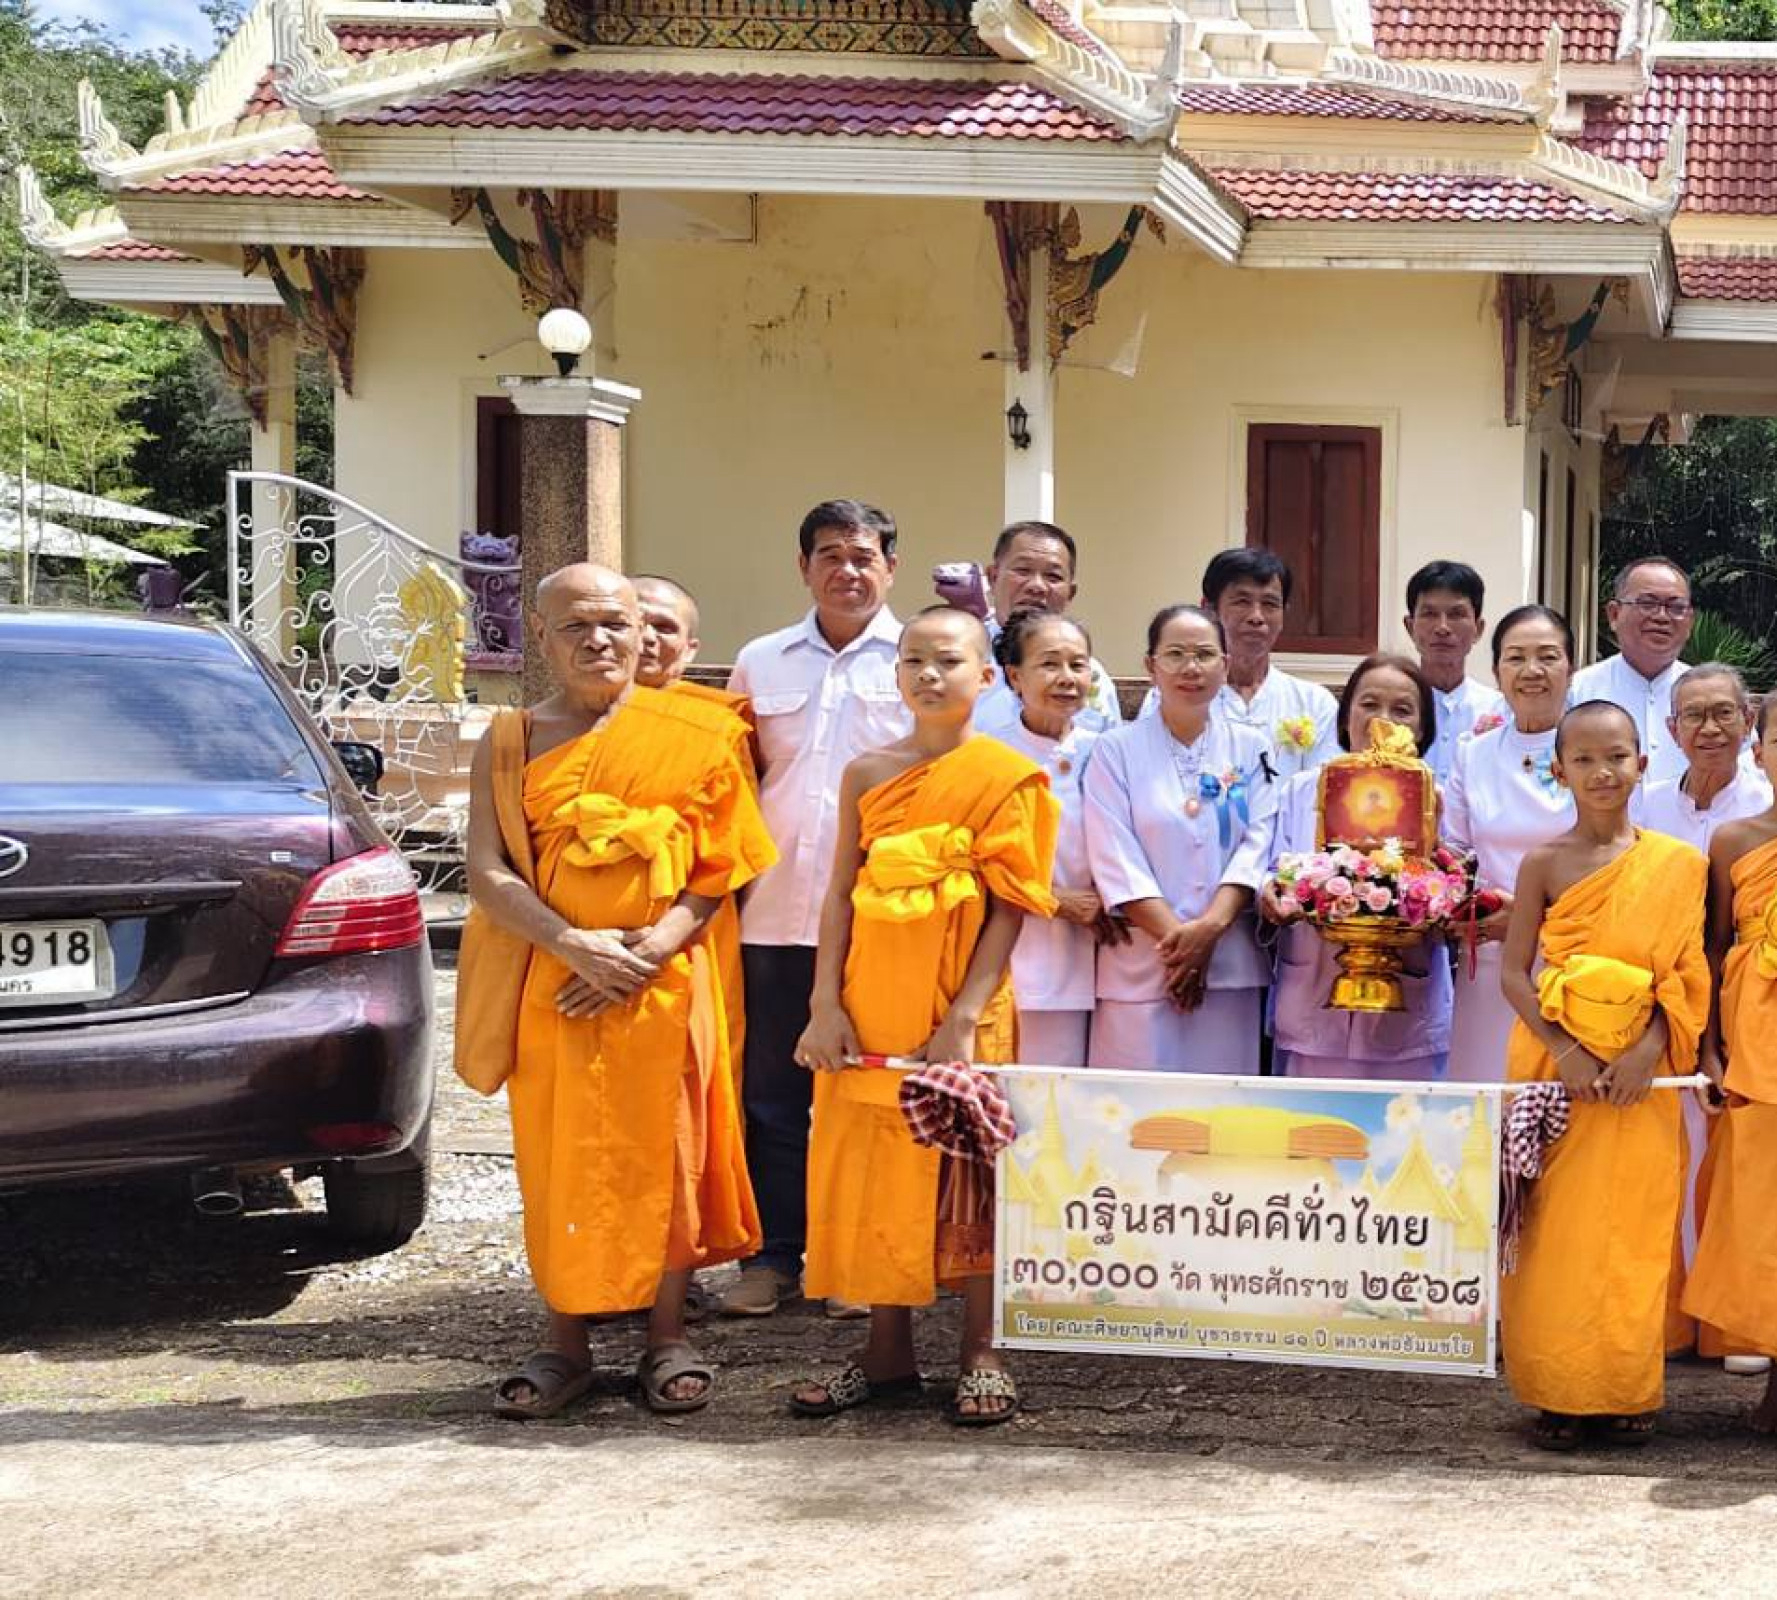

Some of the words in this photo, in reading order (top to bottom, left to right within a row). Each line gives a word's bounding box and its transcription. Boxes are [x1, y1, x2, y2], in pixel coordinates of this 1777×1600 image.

[1064, 1183, 1429, 1247] กฐินสามัคคีทั่วไทย
[1013, 1257, 1159, 1291] ๓๐,๐๐๐
[1170, 1260, 1201, 1292] วัด
[1209, 1265, 1348, 1304] พุทธศักราช
[1361, 1270, 1481, 1305] ๒๕๖๘
[1017, 1312, 1047, 1333] โดย
[1314, 1329, 1327, 1348] ปี
